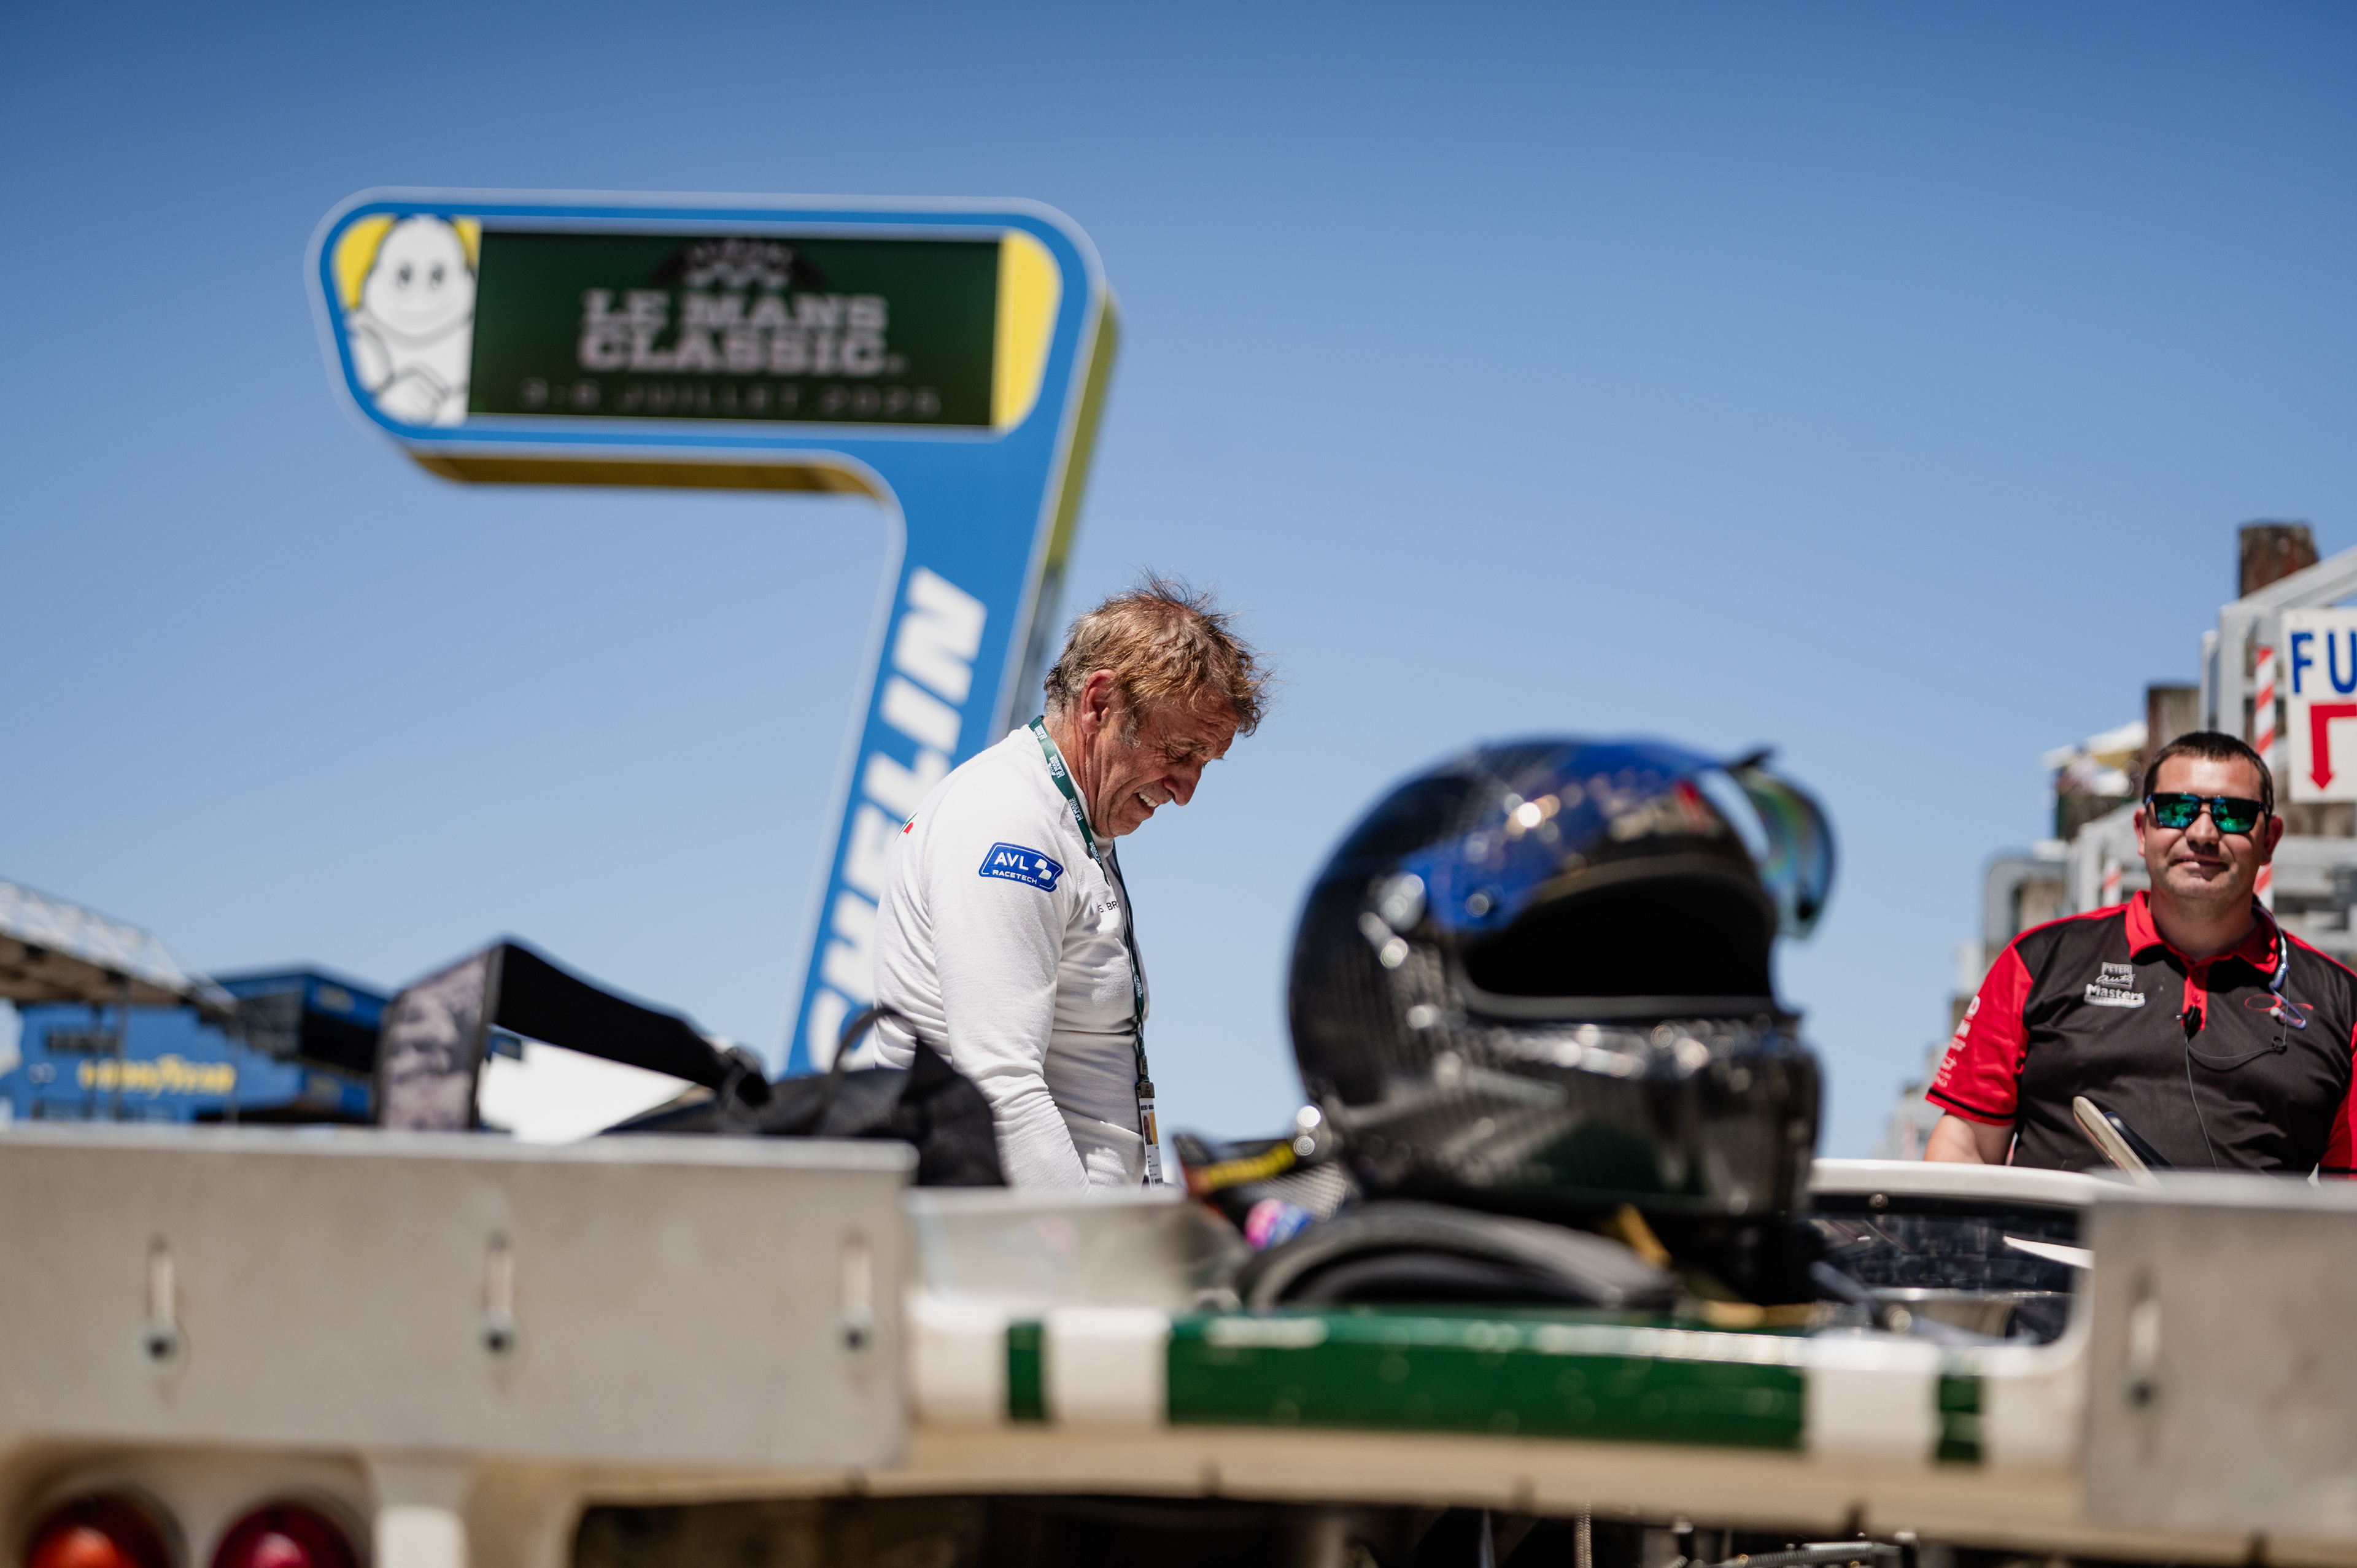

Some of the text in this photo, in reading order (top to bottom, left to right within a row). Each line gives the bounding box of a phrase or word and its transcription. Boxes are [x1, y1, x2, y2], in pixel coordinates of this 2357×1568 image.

[582, 287, 889, 332] LE MANS
[616, 379, 803, 415] JUILLET
[1050, 756, 1059, 772] MANS
[1069, 798, 1078, 814] MANS
[994, 851, 1029, 871] AVL
[993, 869, 1038, 884] RACETECH
[2103, 964, 2131, 975] PETER
[2086, 983, 2145, 1000] Masters
